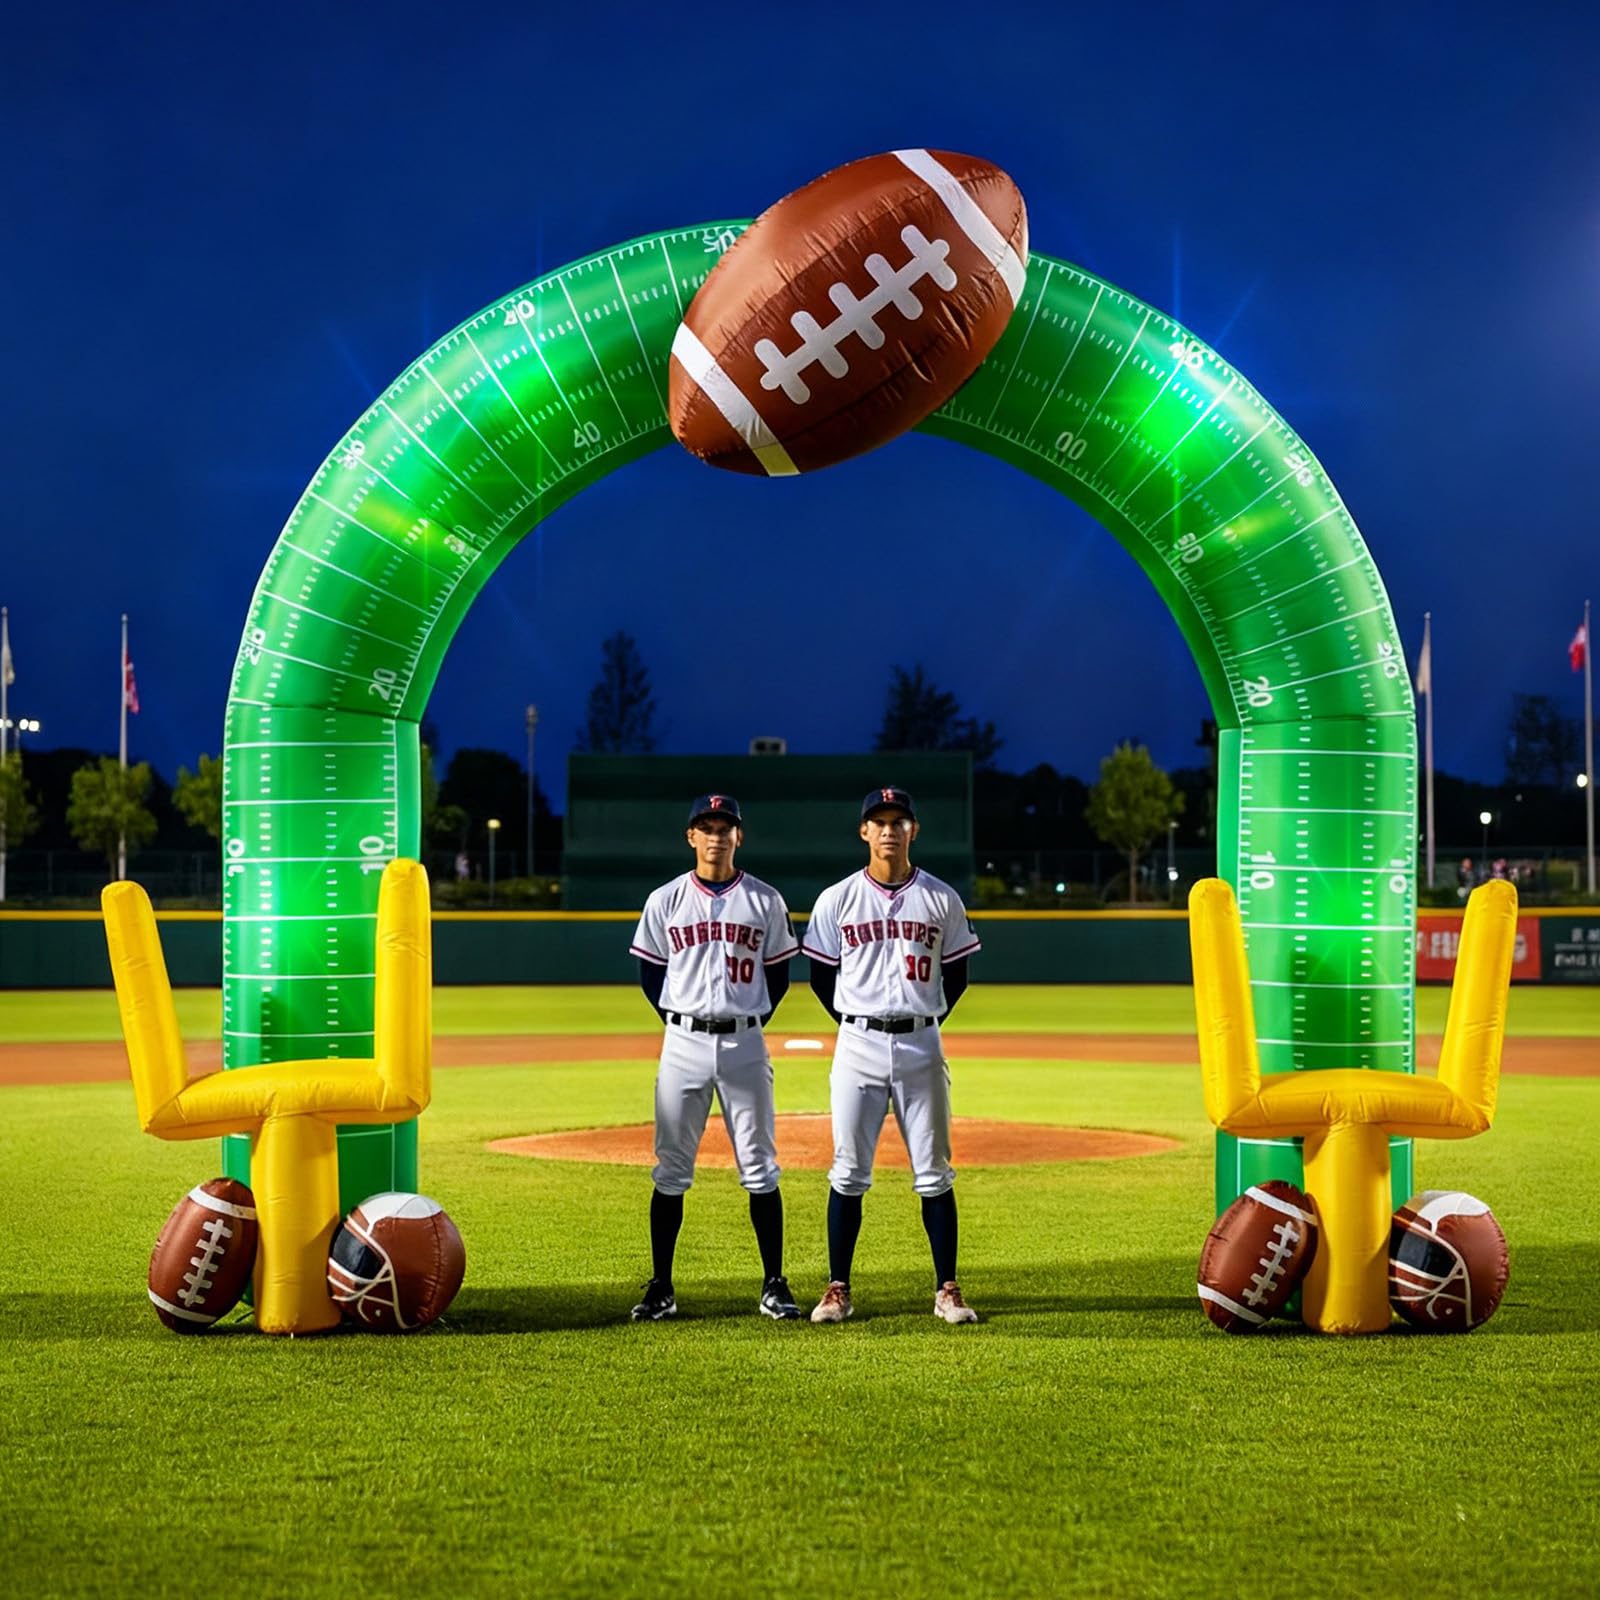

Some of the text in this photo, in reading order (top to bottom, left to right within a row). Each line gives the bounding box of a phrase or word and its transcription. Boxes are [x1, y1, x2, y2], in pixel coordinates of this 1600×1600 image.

[503, 299, 536, 327] 40
[573, 420, 601, 449] 40
[1054, 430, 1088, 462] 00
[1376, 640, 1400, 680] 20
[367, 666, 398, 702] 20
[1242, 675, 1274, 708] 20
[226, 837, 246, 878] 10
[358, 835, 388, 876] 10
[1249, 850, 1277, 890] 10
[1388, 854, 1413, 895] 10
